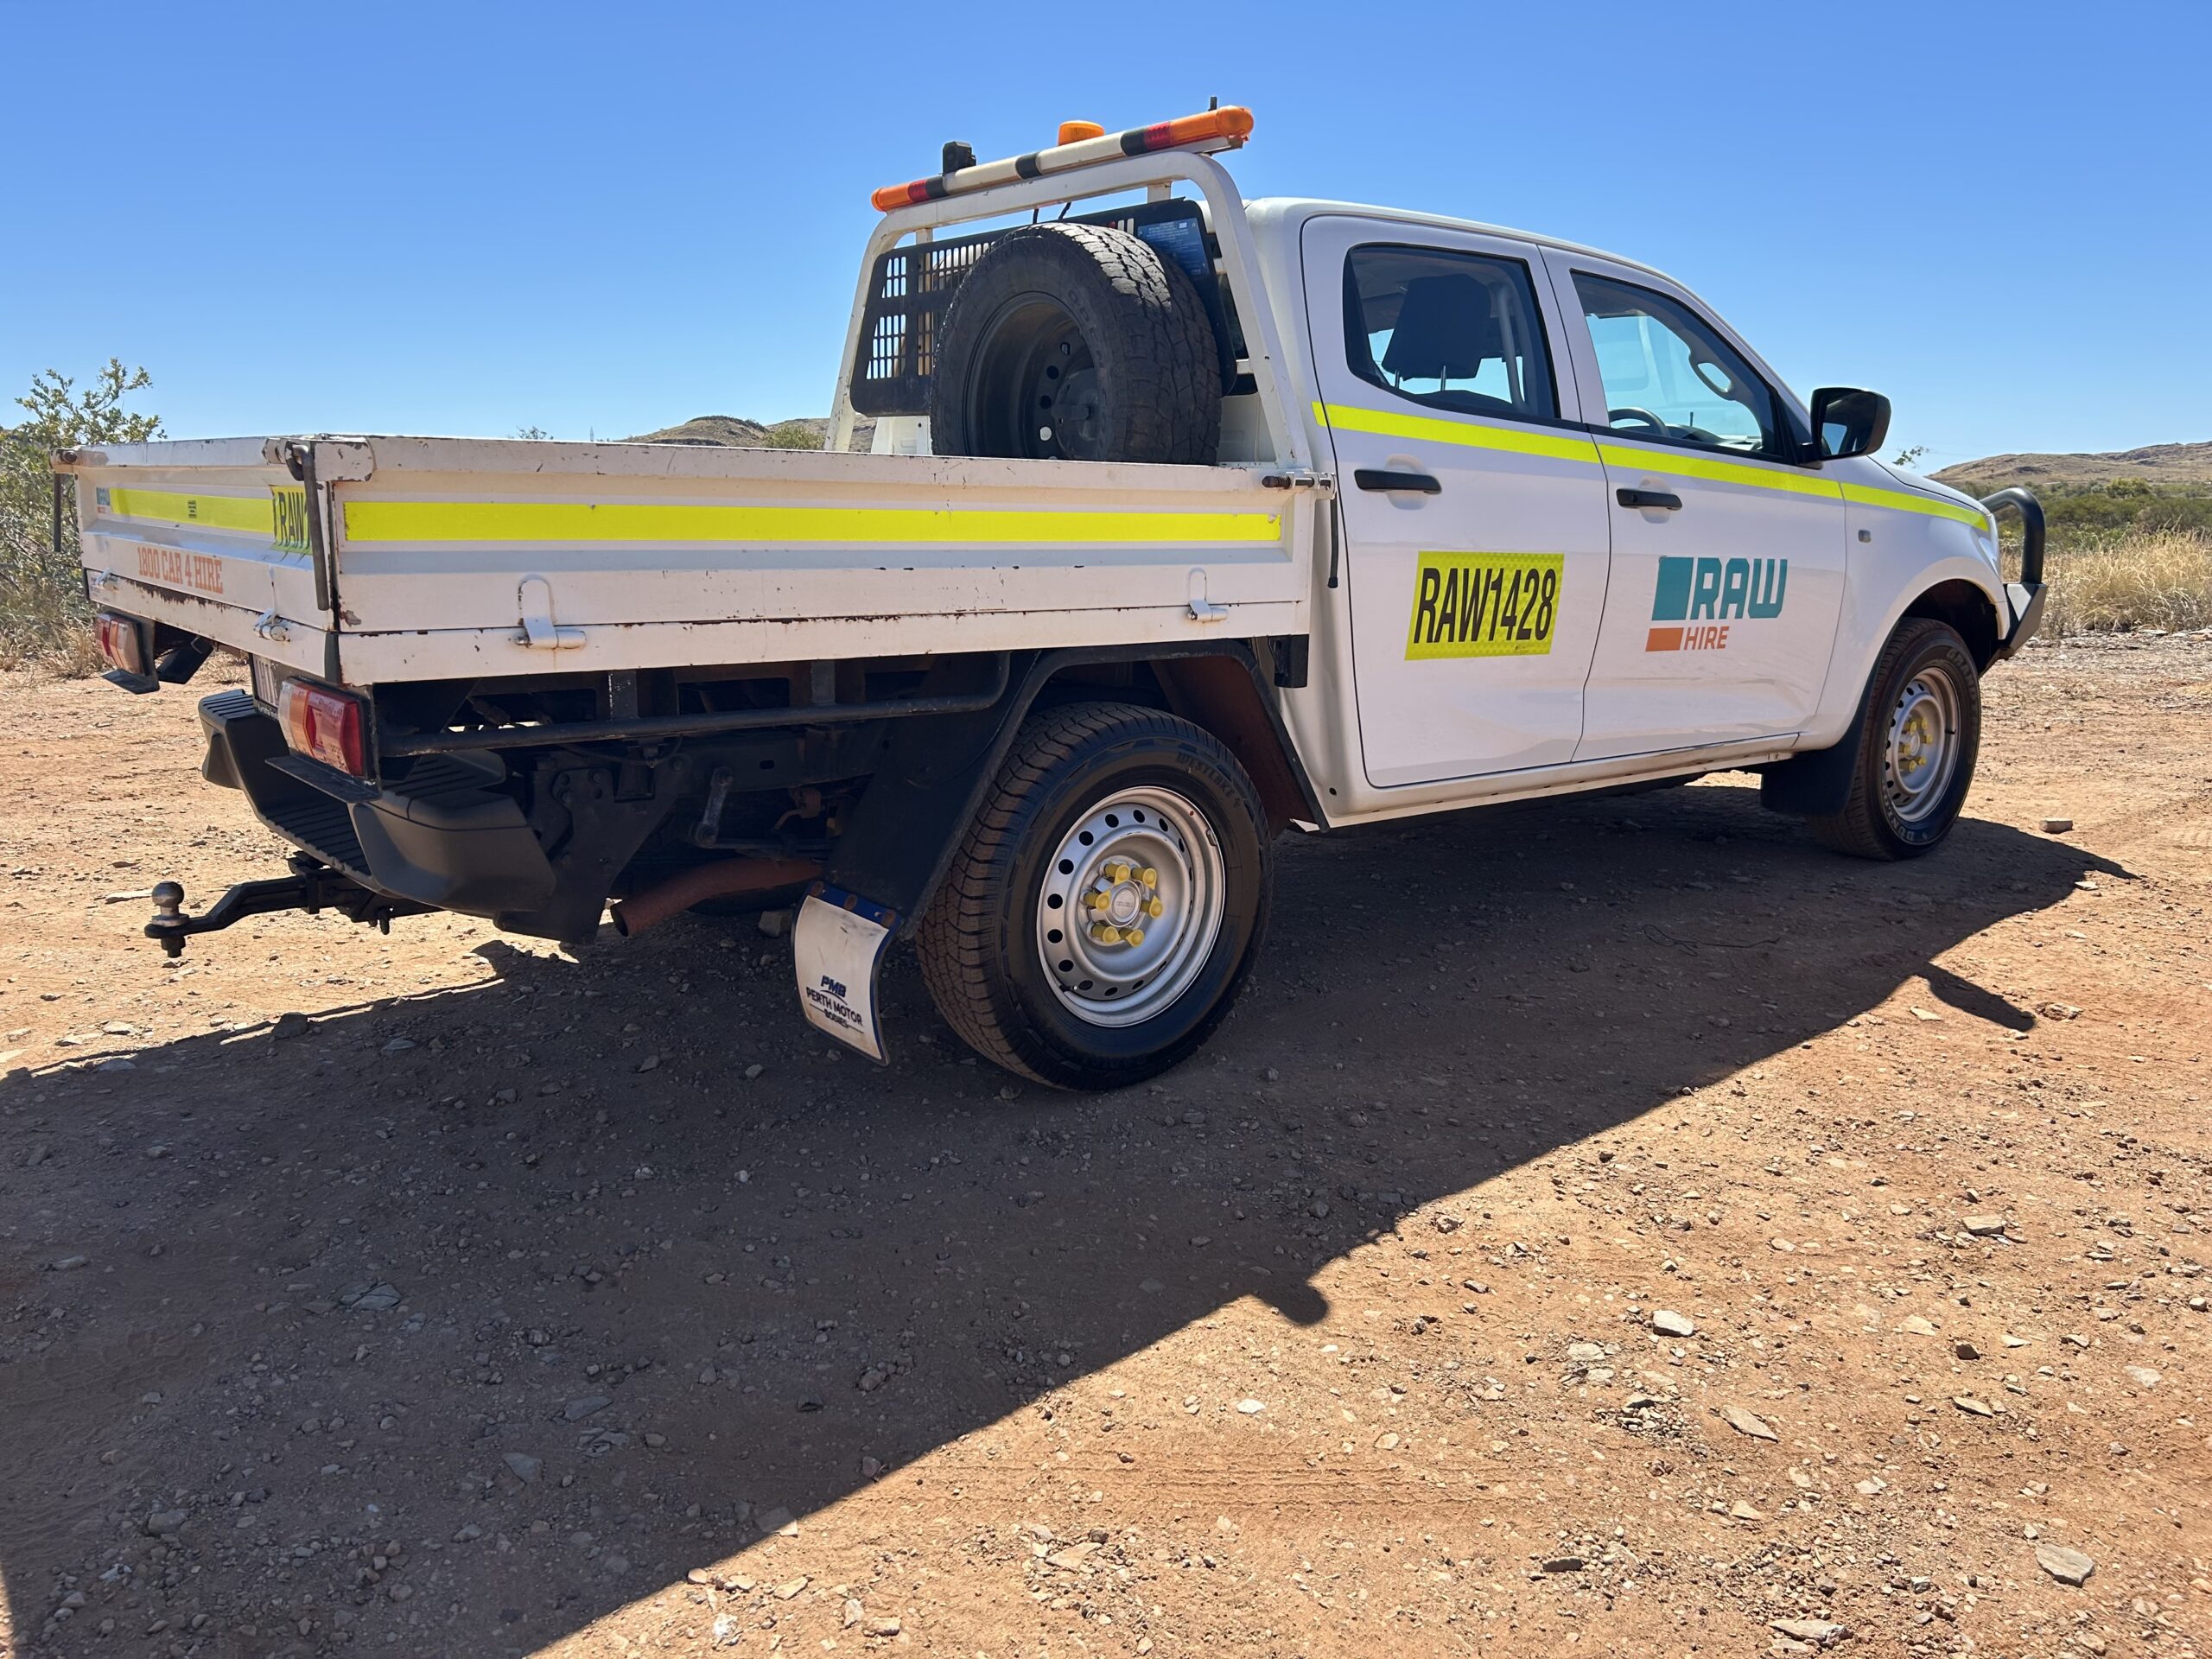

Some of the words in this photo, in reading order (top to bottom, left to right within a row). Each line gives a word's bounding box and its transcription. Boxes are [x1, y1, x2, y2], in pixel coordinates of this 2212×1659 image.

[137, 546, 160, 579] 1800
[161, 550, 183, 584] CAR
[185, 554, 193, 587] 4
[193, 556, 224, 594] HIRE
[1690, 557, 1788, 620] RAW
[1414, 568, 1556, 644] RAW1428
[1683, 626, 1730, 650] HIRE
[806, 986, 832, 1009] PERTH
[833, 1001, 863, 1027] MOTOR
[821, 975, 846, 998] PMB
